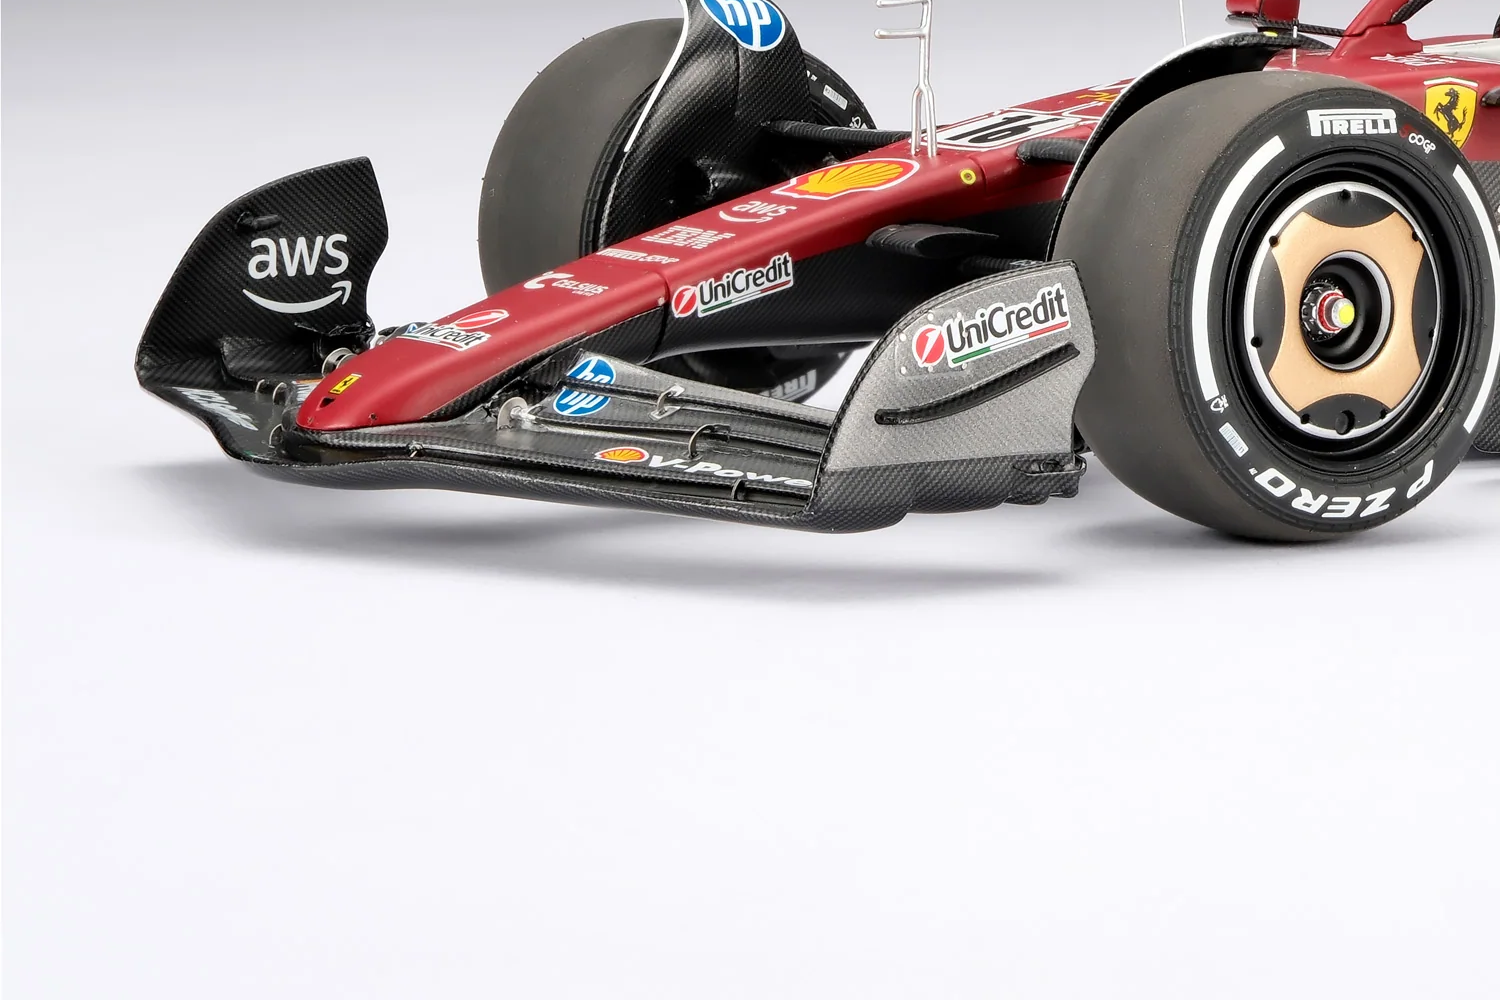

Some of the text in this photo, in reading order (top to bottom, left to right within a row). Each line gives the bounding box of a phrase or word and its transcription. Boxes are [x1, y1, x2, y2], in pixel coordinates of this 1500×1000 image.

[944, 114, 1064, 143] 16
[1307, 109, 1397, 137] PIRELLI
[732, 201, 797, 216] aws
[248, 233, 349, 279] aws
[552, 279, 608, 294] CELSIUS
[699, 254, 791, 306] UniCredit
[946, 288, 1068, 353] UniCredit
[649, 455, 813, 488] V-Powe
[1254, 460, 1434, 518] P ZERO
